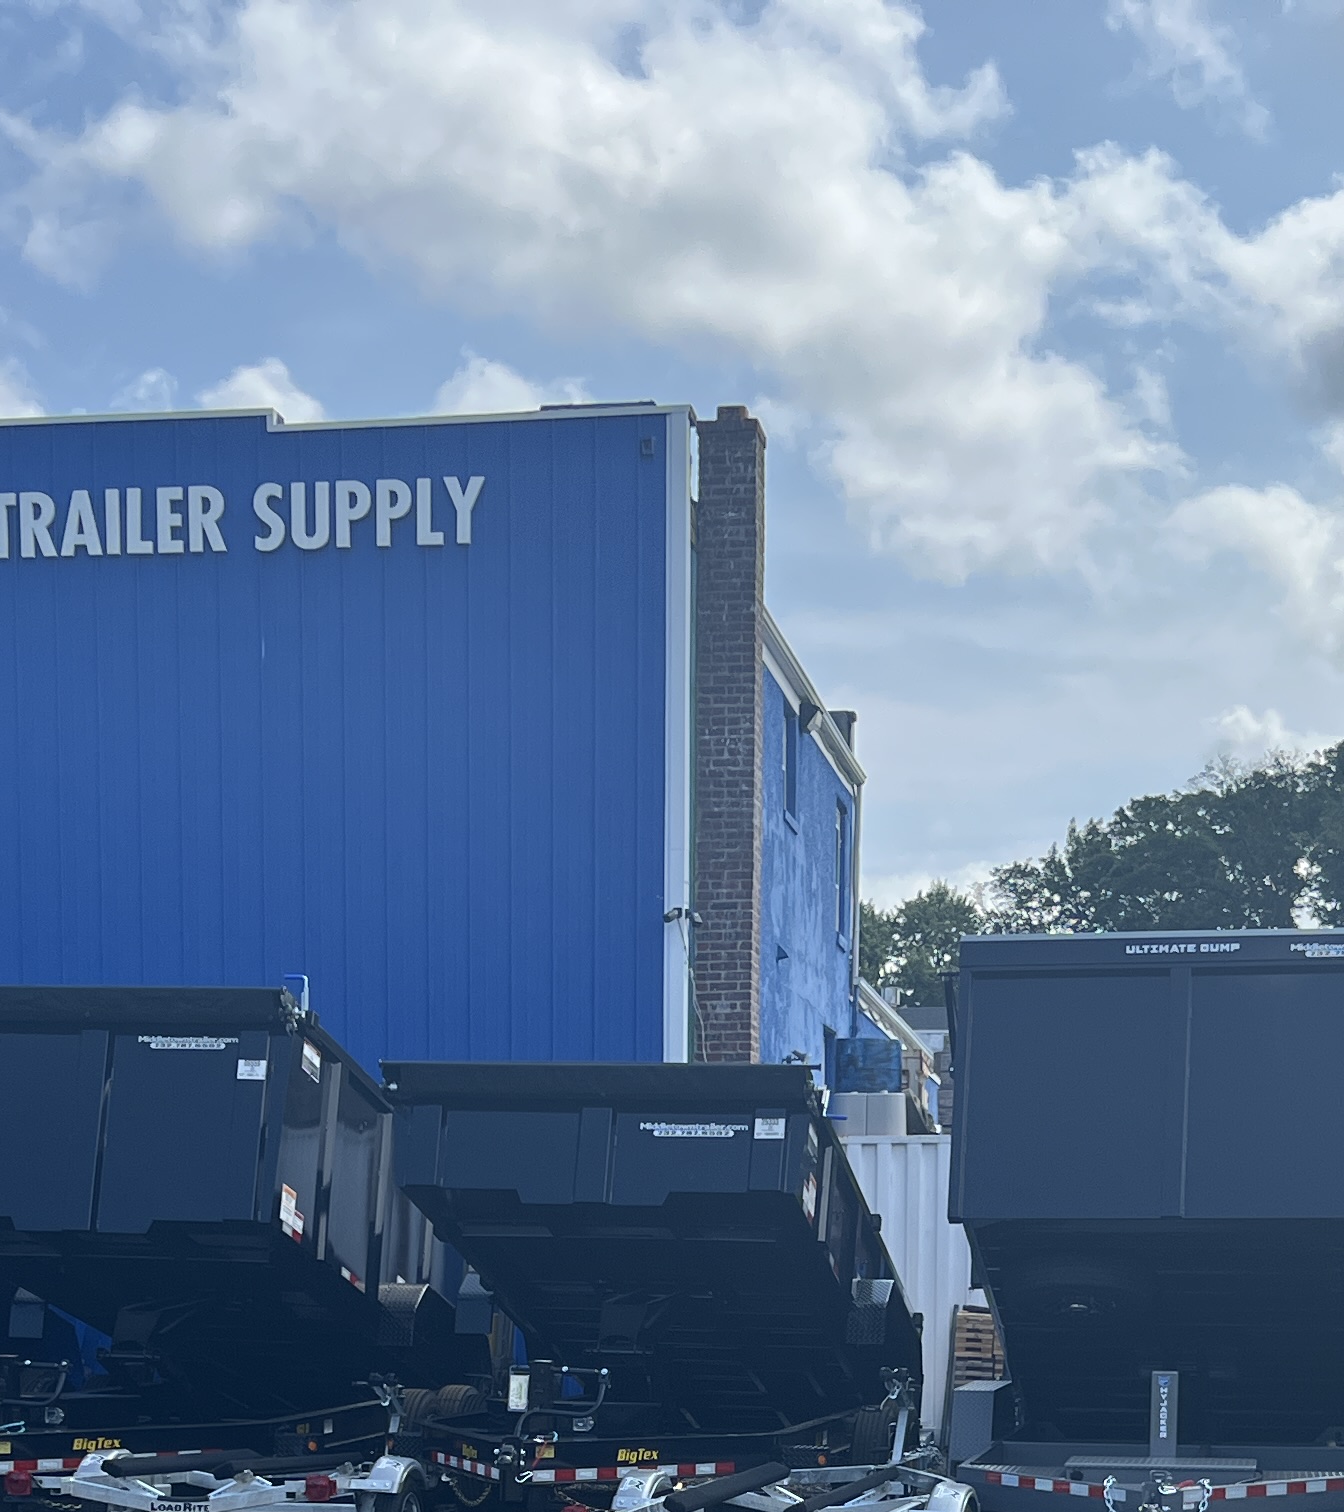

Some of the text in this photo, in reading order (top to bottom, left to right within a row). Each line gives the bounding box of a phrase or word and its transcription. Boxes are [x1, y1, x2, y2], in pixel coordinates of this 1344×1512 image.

[253, 475, 485, 552] SUPPLY
[1125, 942, 1241, 954] ULTIMATE DUMP
[640, 1122, 748, 1131] Middletowntrailer.com
[72, 1437, 122, 1452] BigTex
[617, 1447, 659, 1463] BigTex
